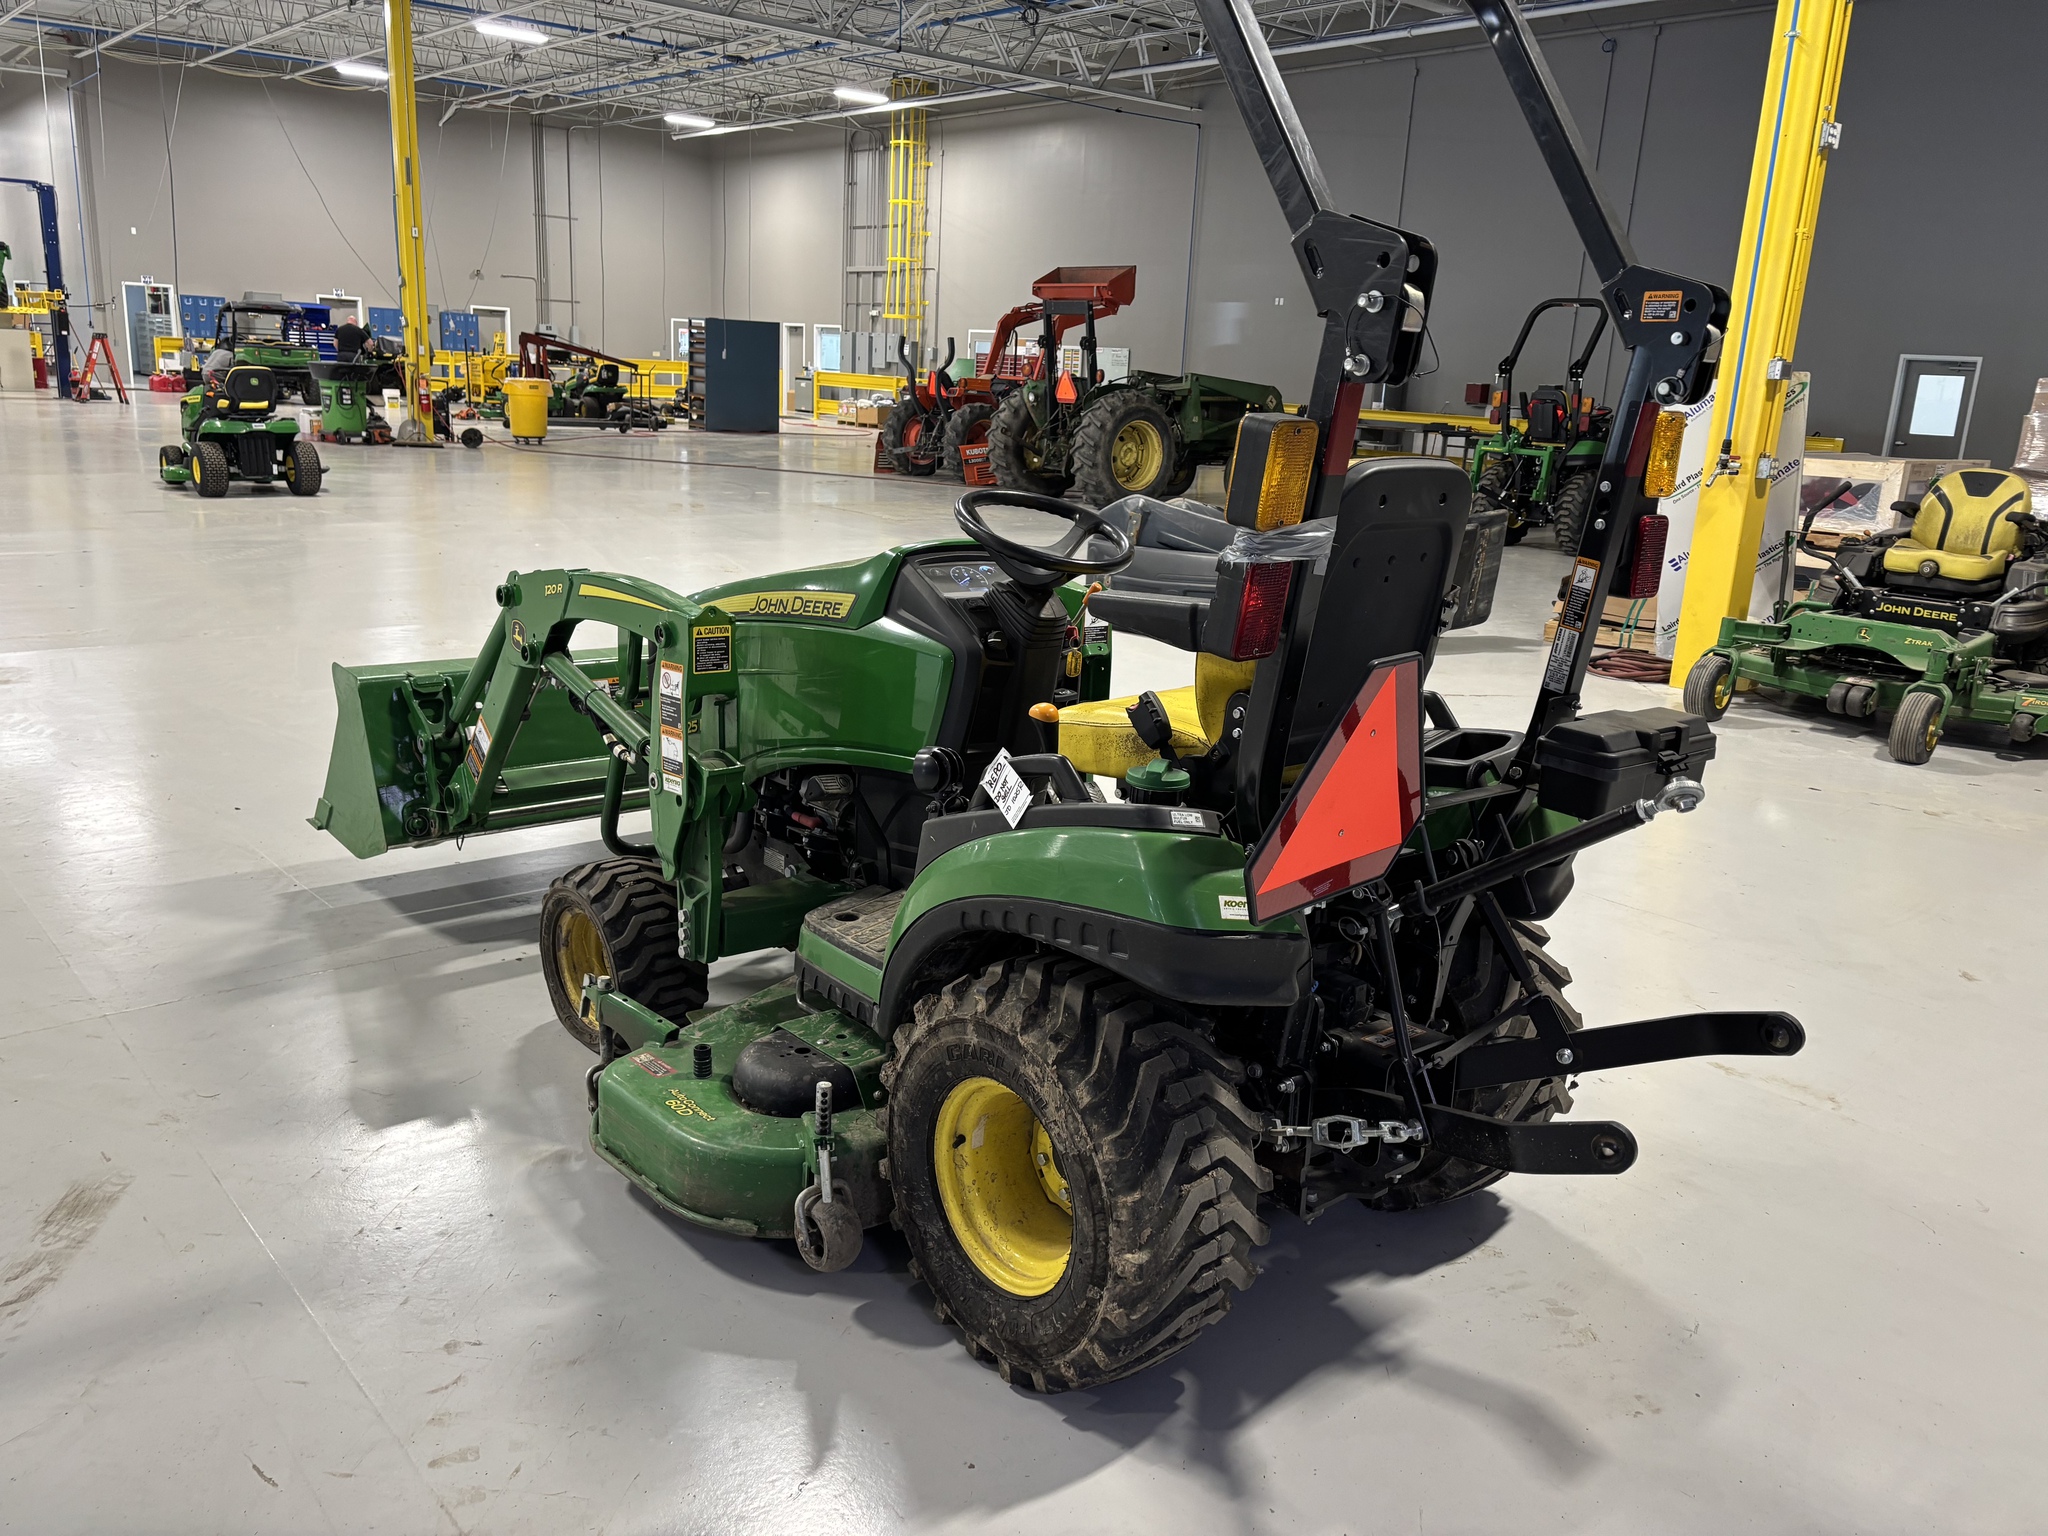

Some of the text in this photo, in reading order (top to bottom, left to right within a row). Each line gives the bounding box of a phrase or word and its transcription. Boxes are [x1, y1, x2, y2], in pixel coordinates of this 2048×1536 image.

[1684, 393, 1716, 420] Aluma
[1772, 459, 1800, 482] anate
[1758, 541, 1785, 559] lastics
[749, 596, 844, 617] JOHN DEERE
[1876, 602, 1958, 622] JOHN DEERE
[703, 626, 730, 636] CAUTION
[1904, 637, 1934, 647] ZTRAK
[2021, 697, 2048, 707] 7IRO
[985, 762, 1003, 789] REPO
[664, 1099, 694, 1116] 60D
[667, 1088, 716, 1122] Auto Connect
